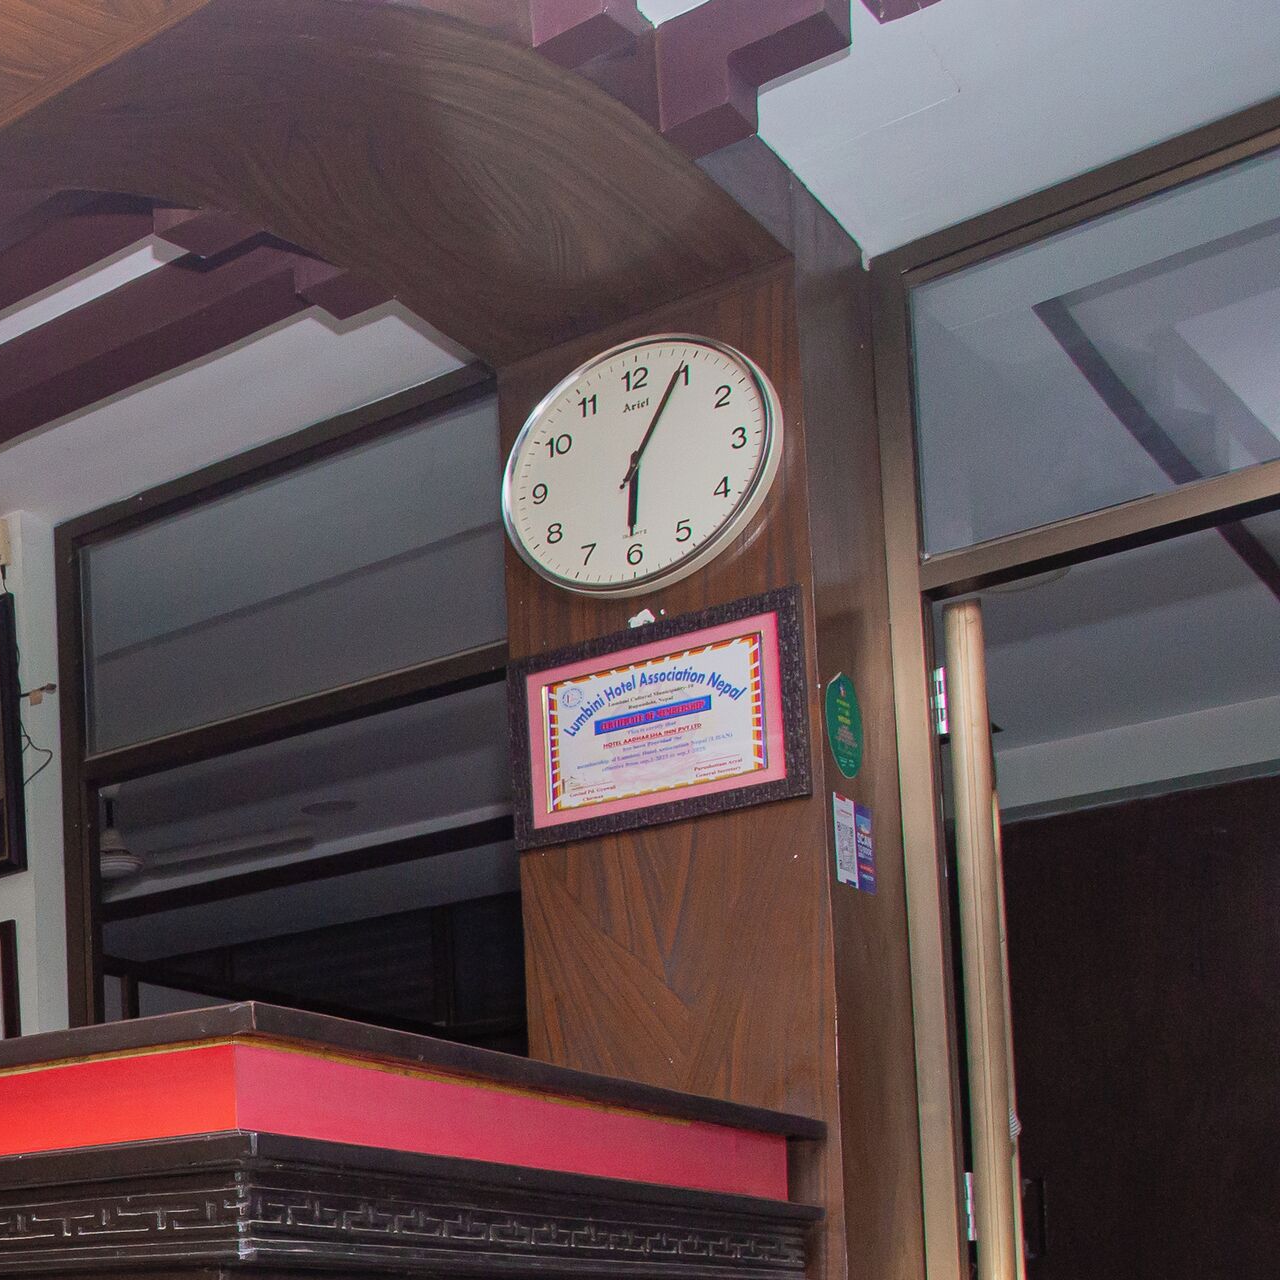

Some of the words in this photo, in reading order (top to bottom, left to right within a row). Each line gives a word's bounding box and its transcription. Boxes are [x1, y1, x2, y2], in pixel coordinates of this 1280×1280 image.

[621, 367, 648, 392] 12
[680, 365, 690, 385] 1
[578, 394, 598, 418] 11
[714, 385, 732, 408] 2
[545, 434, 572, 458] 10
[731, 427, 748, 449] 3
[532, 484, 548, 505] 9
[713, 476, 731, 498] 4
[547, 523, 562, 544] 8
[675, 519, 692, 542] 5
[581, 543, 597, 566] 7
[627, 543, 644, 565] 6
[564, 692, 605, 737] Lumbini
[605, 675, 637, 700] Hotel
[639, 666, 705, 688] Association
[707, 671, 747, 701] Nepal
[602, 739, 622, 749] HOTEL
